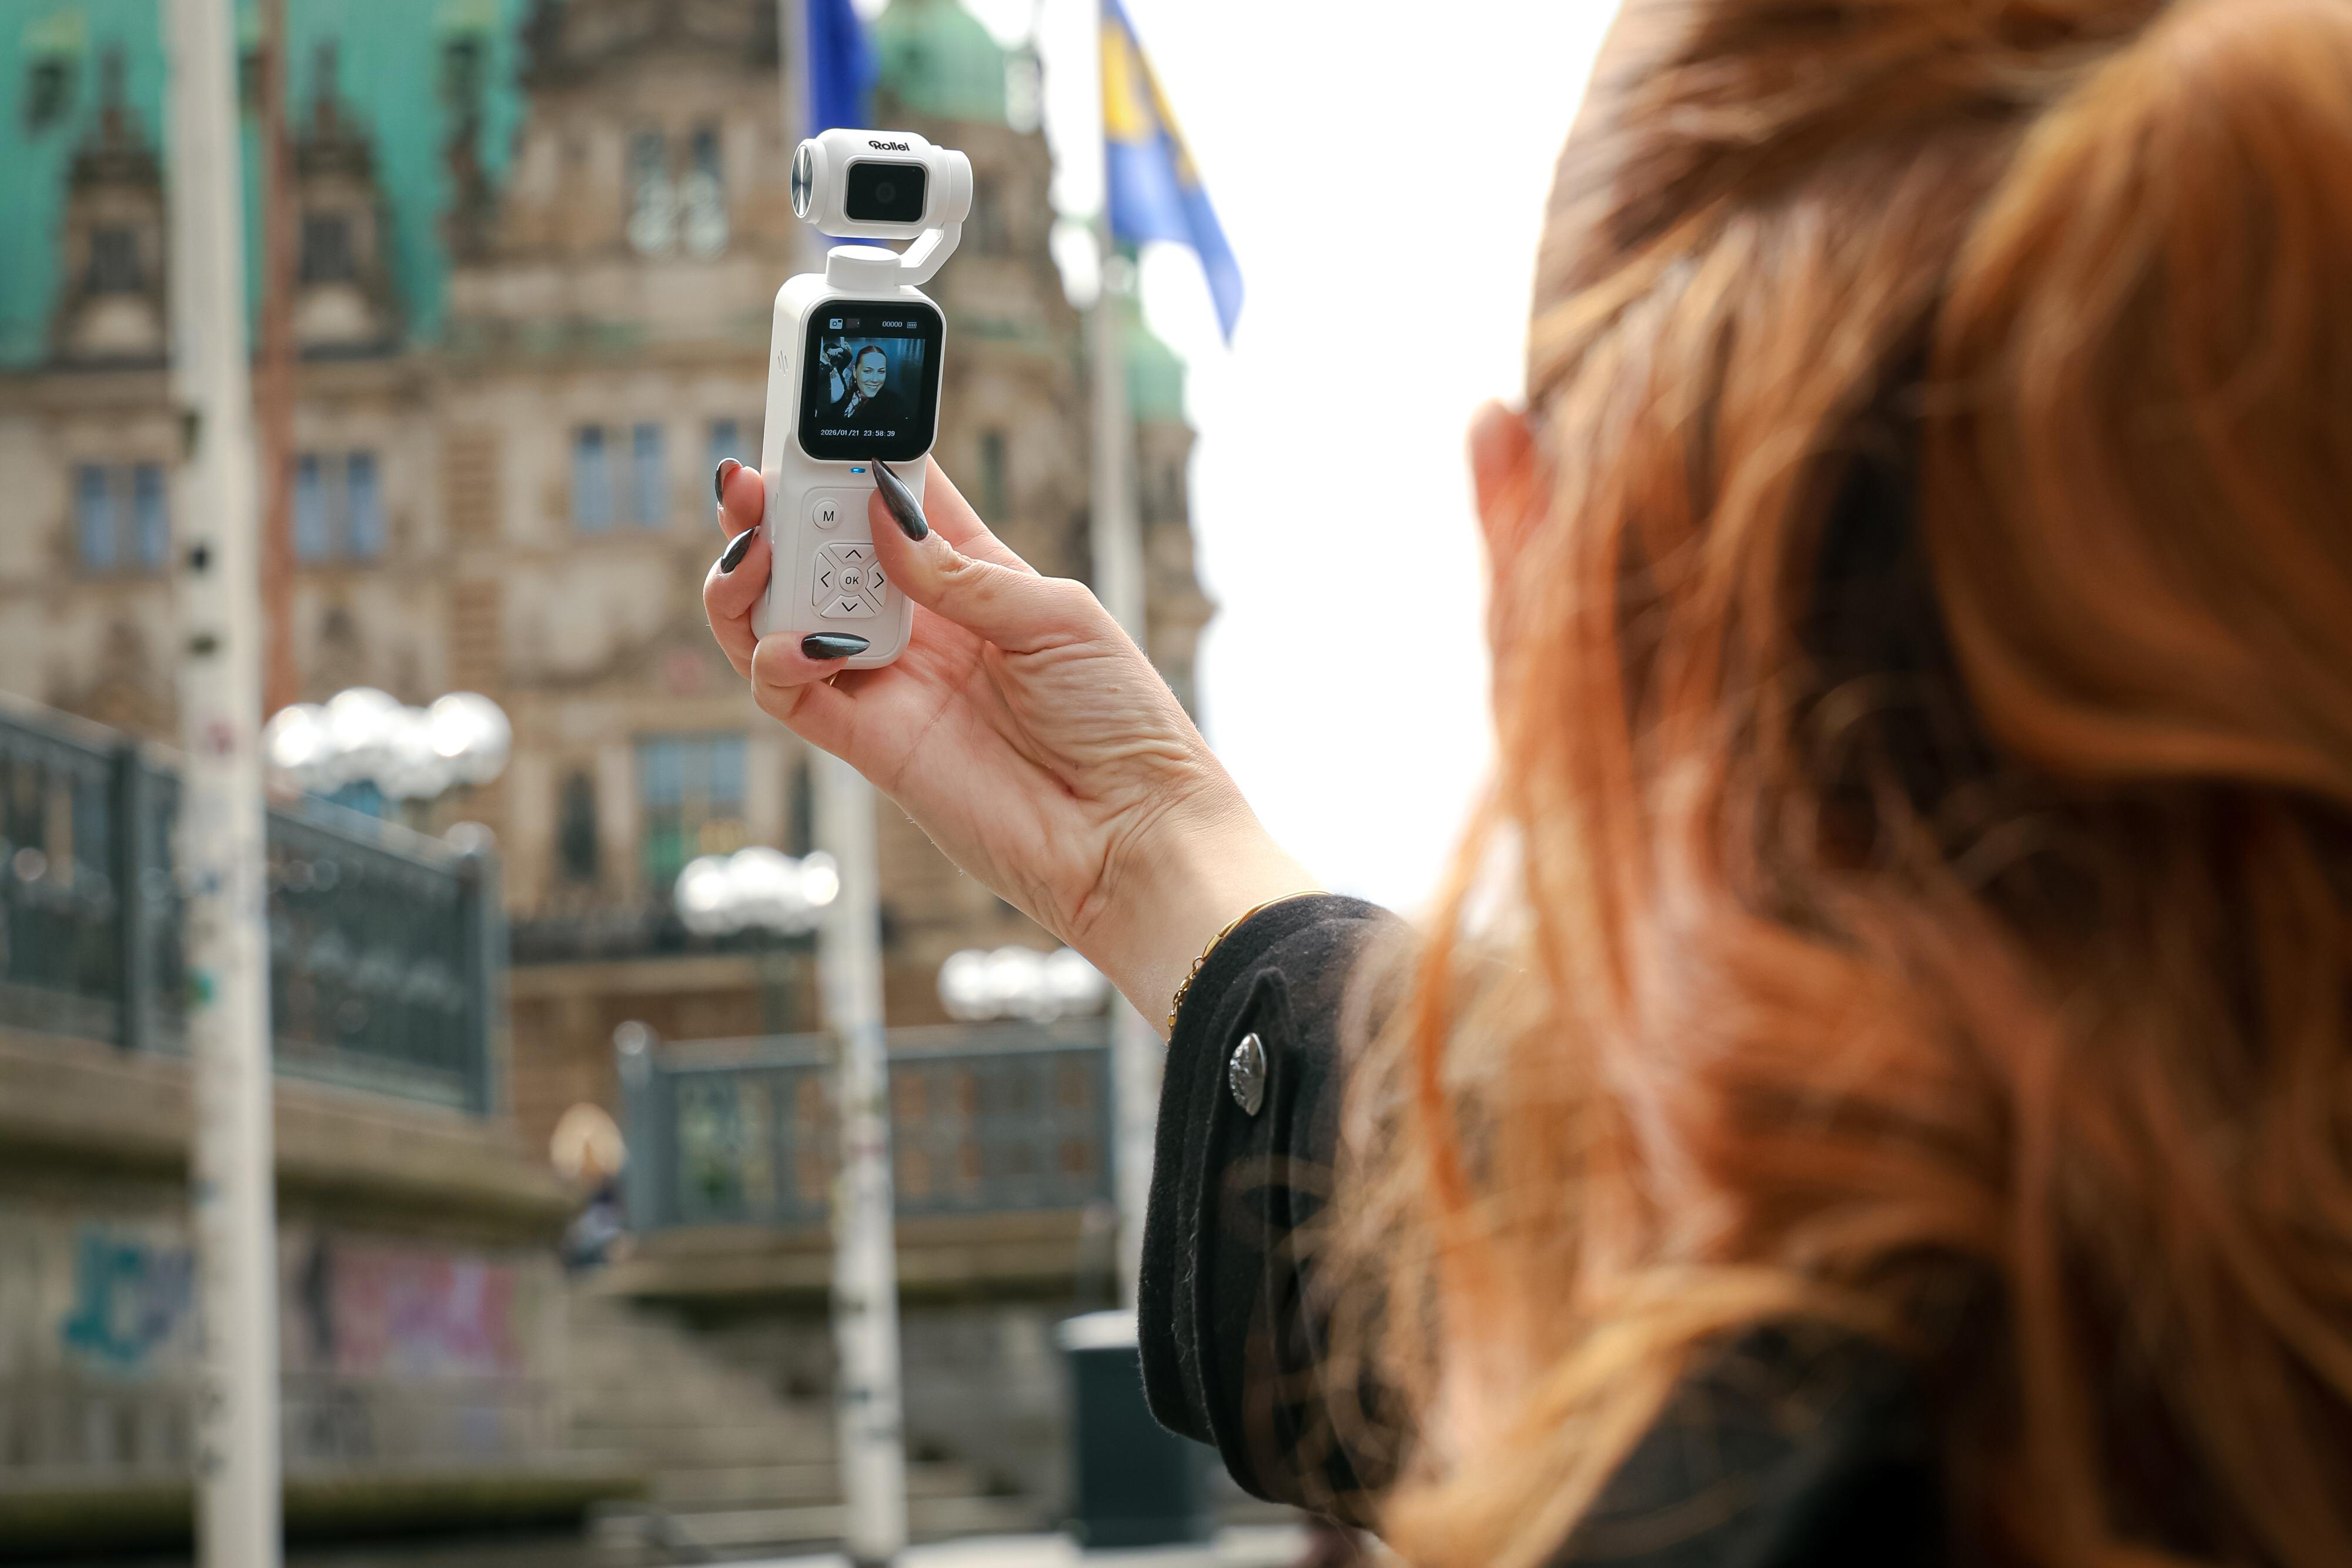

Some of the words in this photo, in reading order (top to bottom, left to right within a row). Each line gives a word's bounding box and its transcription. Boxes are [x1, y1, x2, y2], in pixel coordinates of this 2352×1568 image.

[868, 141, 910, 151] Rollei
[823, 510, 834, 521] M
[845, 576, 859, 584] OK
